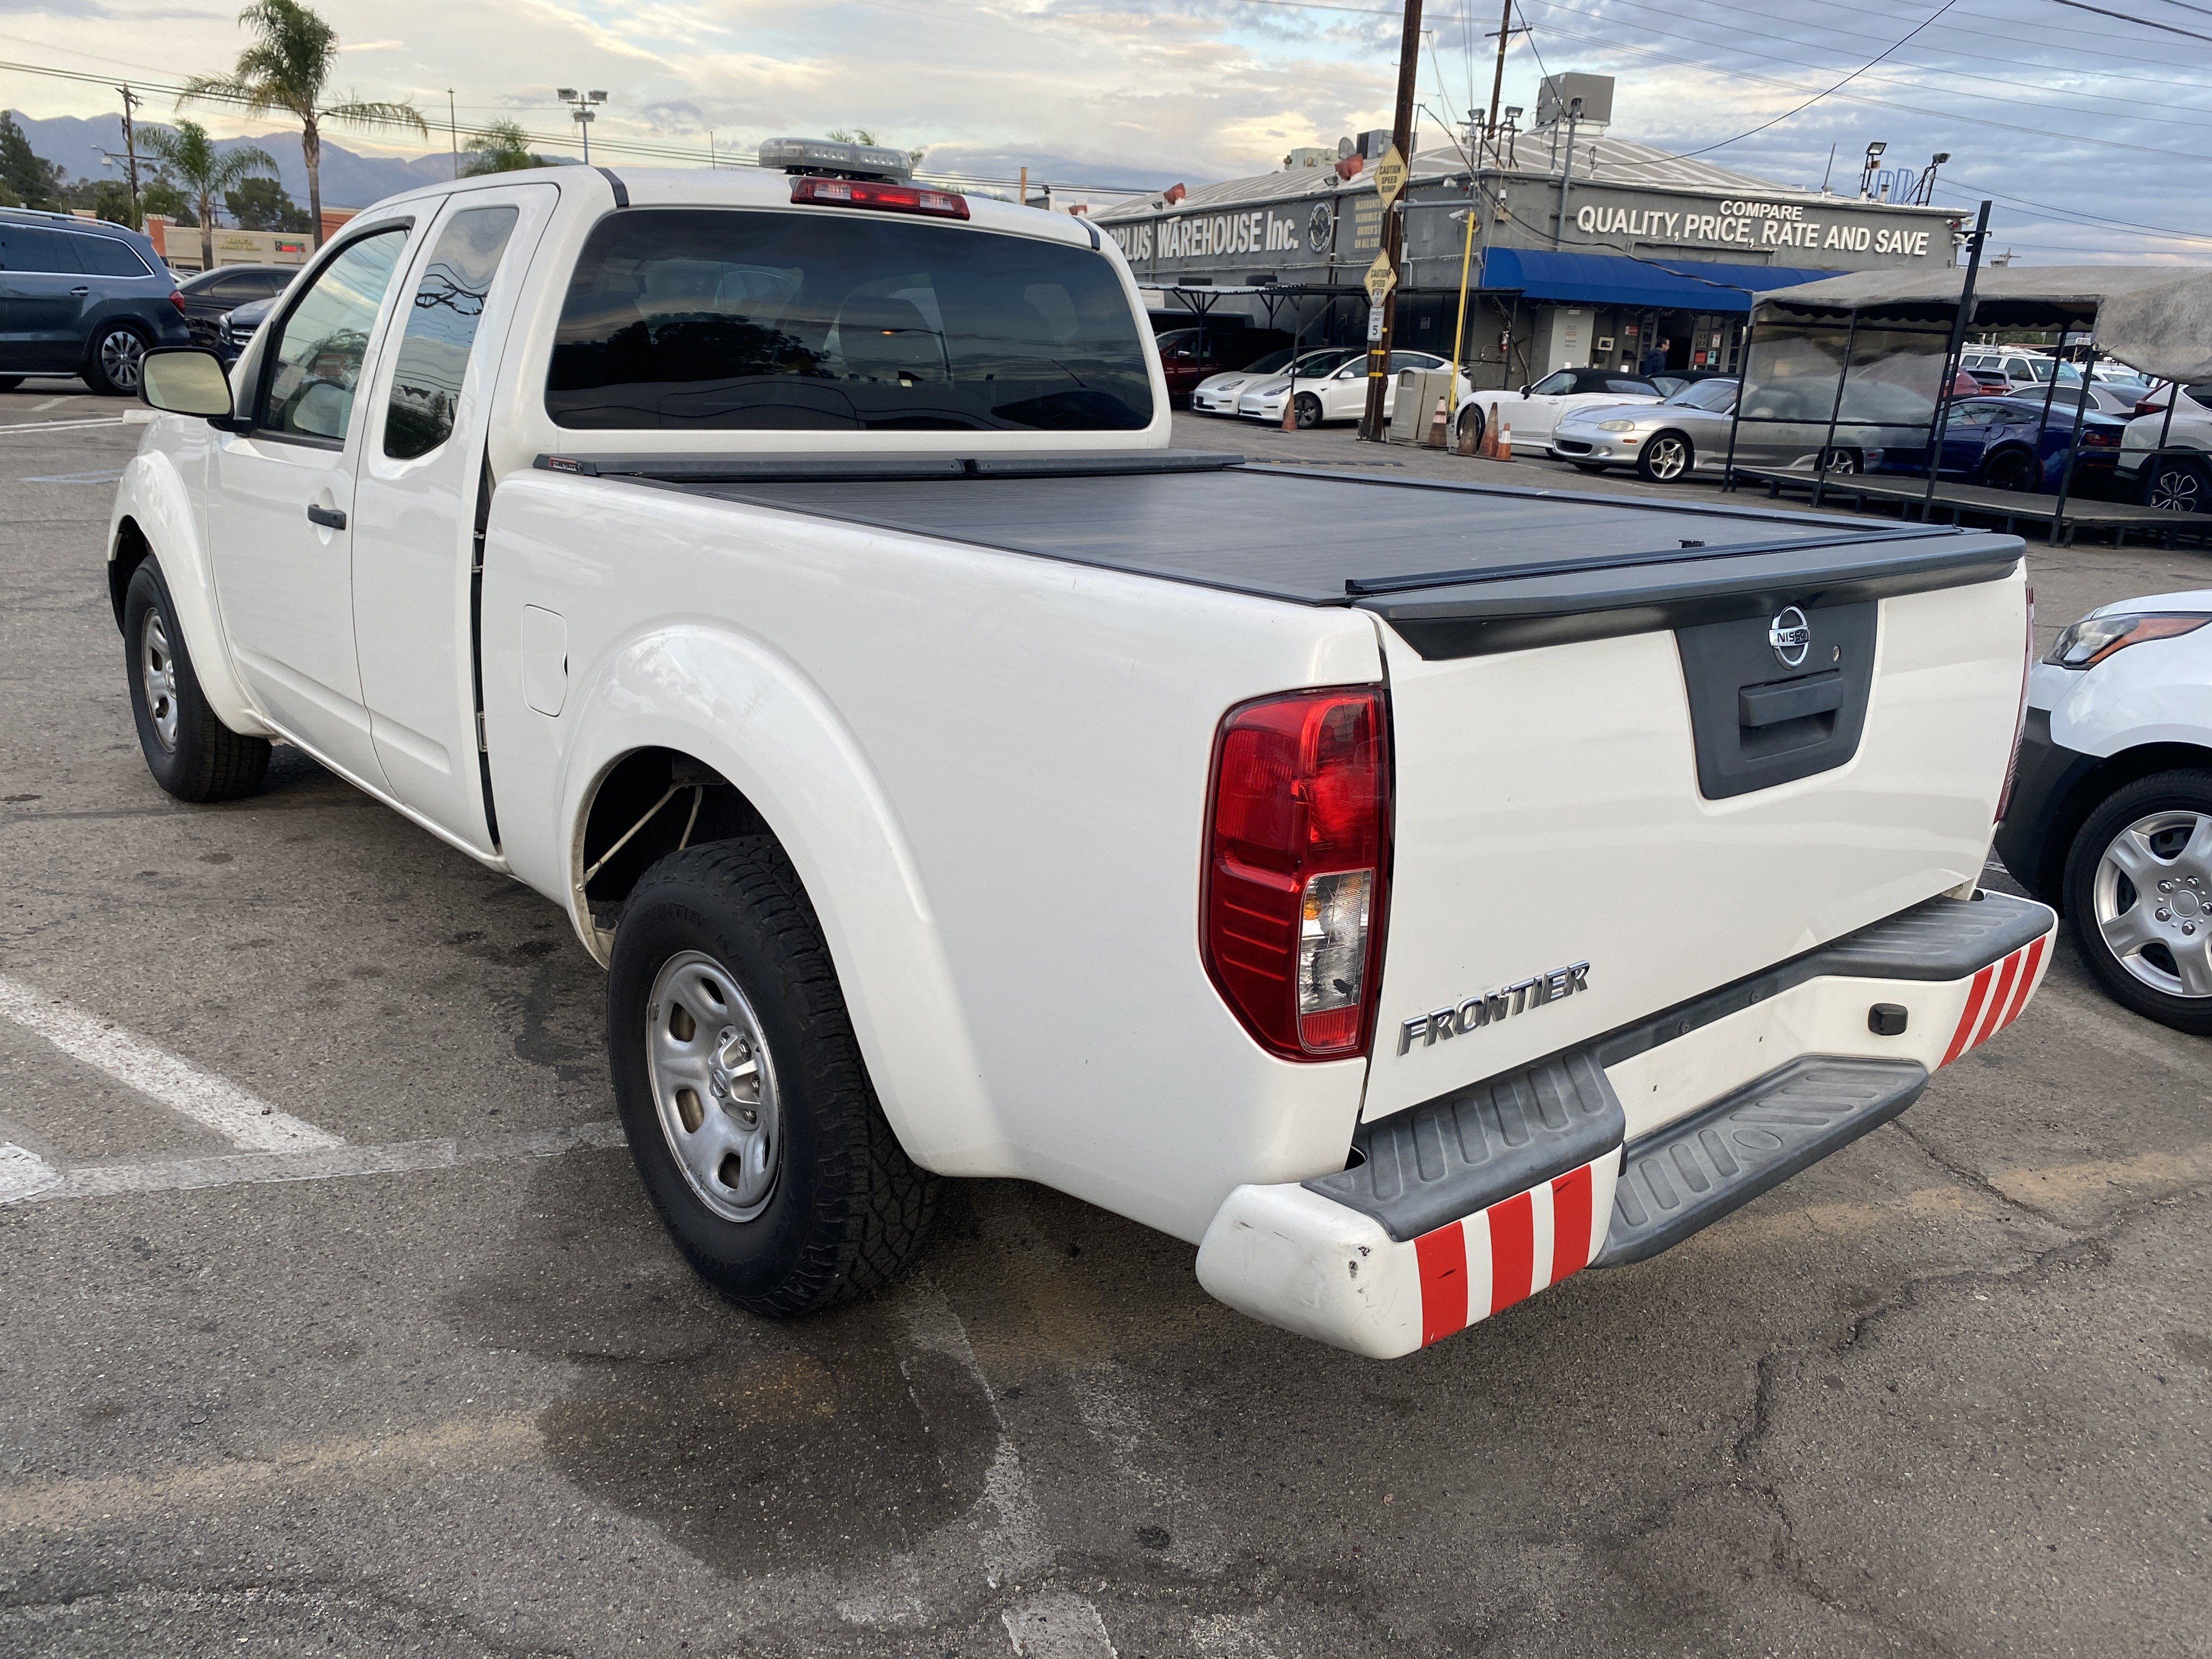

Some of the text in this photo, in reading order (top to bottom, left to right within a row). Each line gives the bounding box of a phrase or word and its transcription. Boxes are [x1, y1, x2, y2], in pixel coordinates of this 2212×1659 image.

[1379, 165, 1402, 175] CAUTION
[1381, 176, 1398, 184] SPEED
[1381, 185, 1396, 193] BUMP
[1719, 200, 1803, 221] COMPARE
[1158, 211, 1263, 258] WAREHOUSE
[1266, 210, 1299, 251] Inc.
[1577, 205, 1930, 256] QUALITY, PRICE, RATE AND SAVE
[1370, 269, 1390, 278] CAUTION
[1372, 325, 1379, 335] 5
[1397, 960, 1590, 1057] FRONTIER
